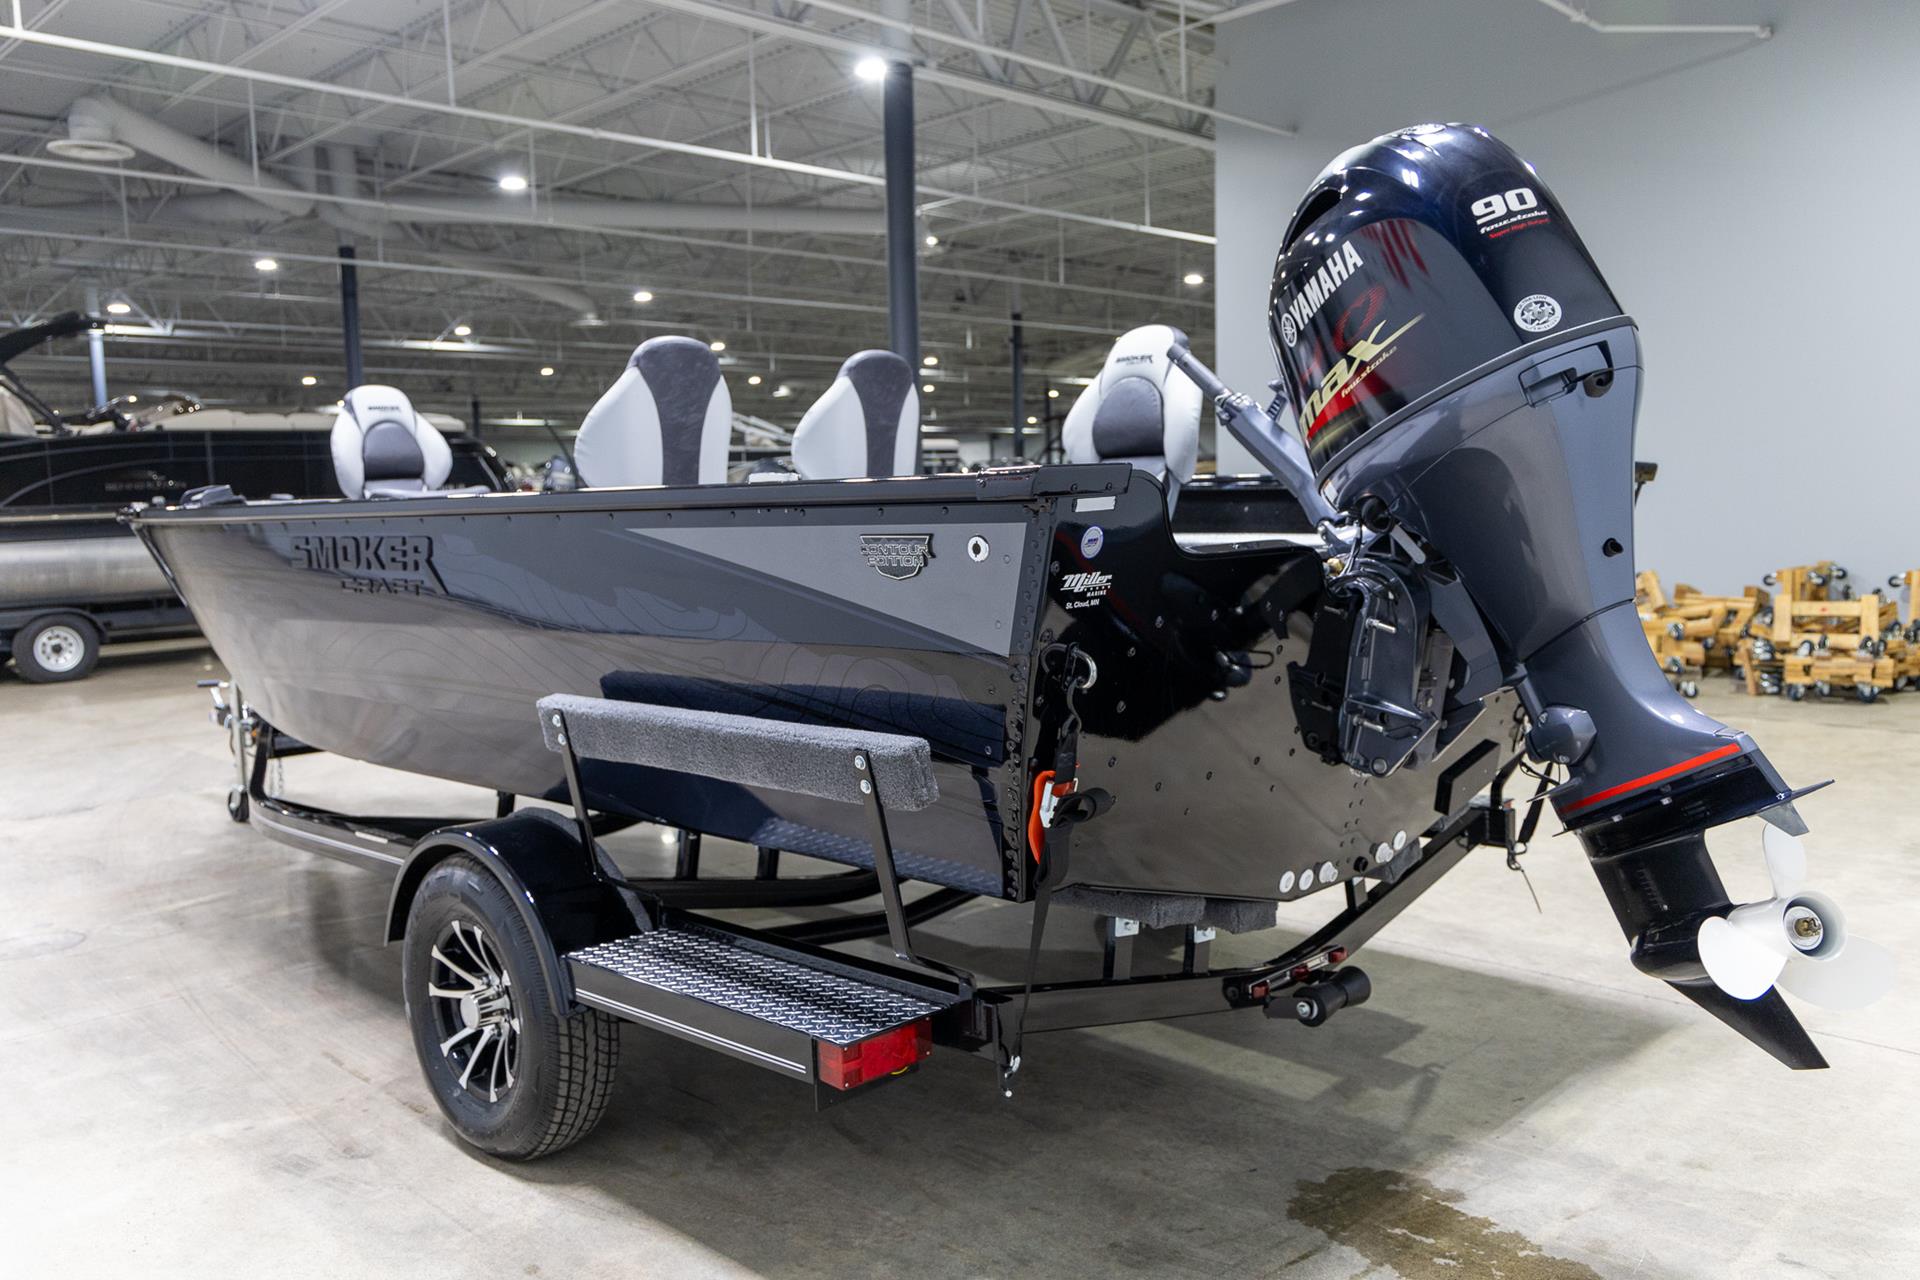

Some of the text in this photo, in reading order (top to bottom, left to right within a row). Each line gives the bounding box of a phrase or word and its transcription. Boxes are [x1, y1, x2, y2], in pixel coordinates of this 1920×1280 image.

[1471, 188, 1538, 225] 90
[1289, 240, 1364, 331] YAMAHA
[290, 535, 449, 595] SMOKER
[860, 543, 931, 559] CONTOUR
[866, 555, 925, 567] EDITION
[1061, 571, 1112, 592] Miller
